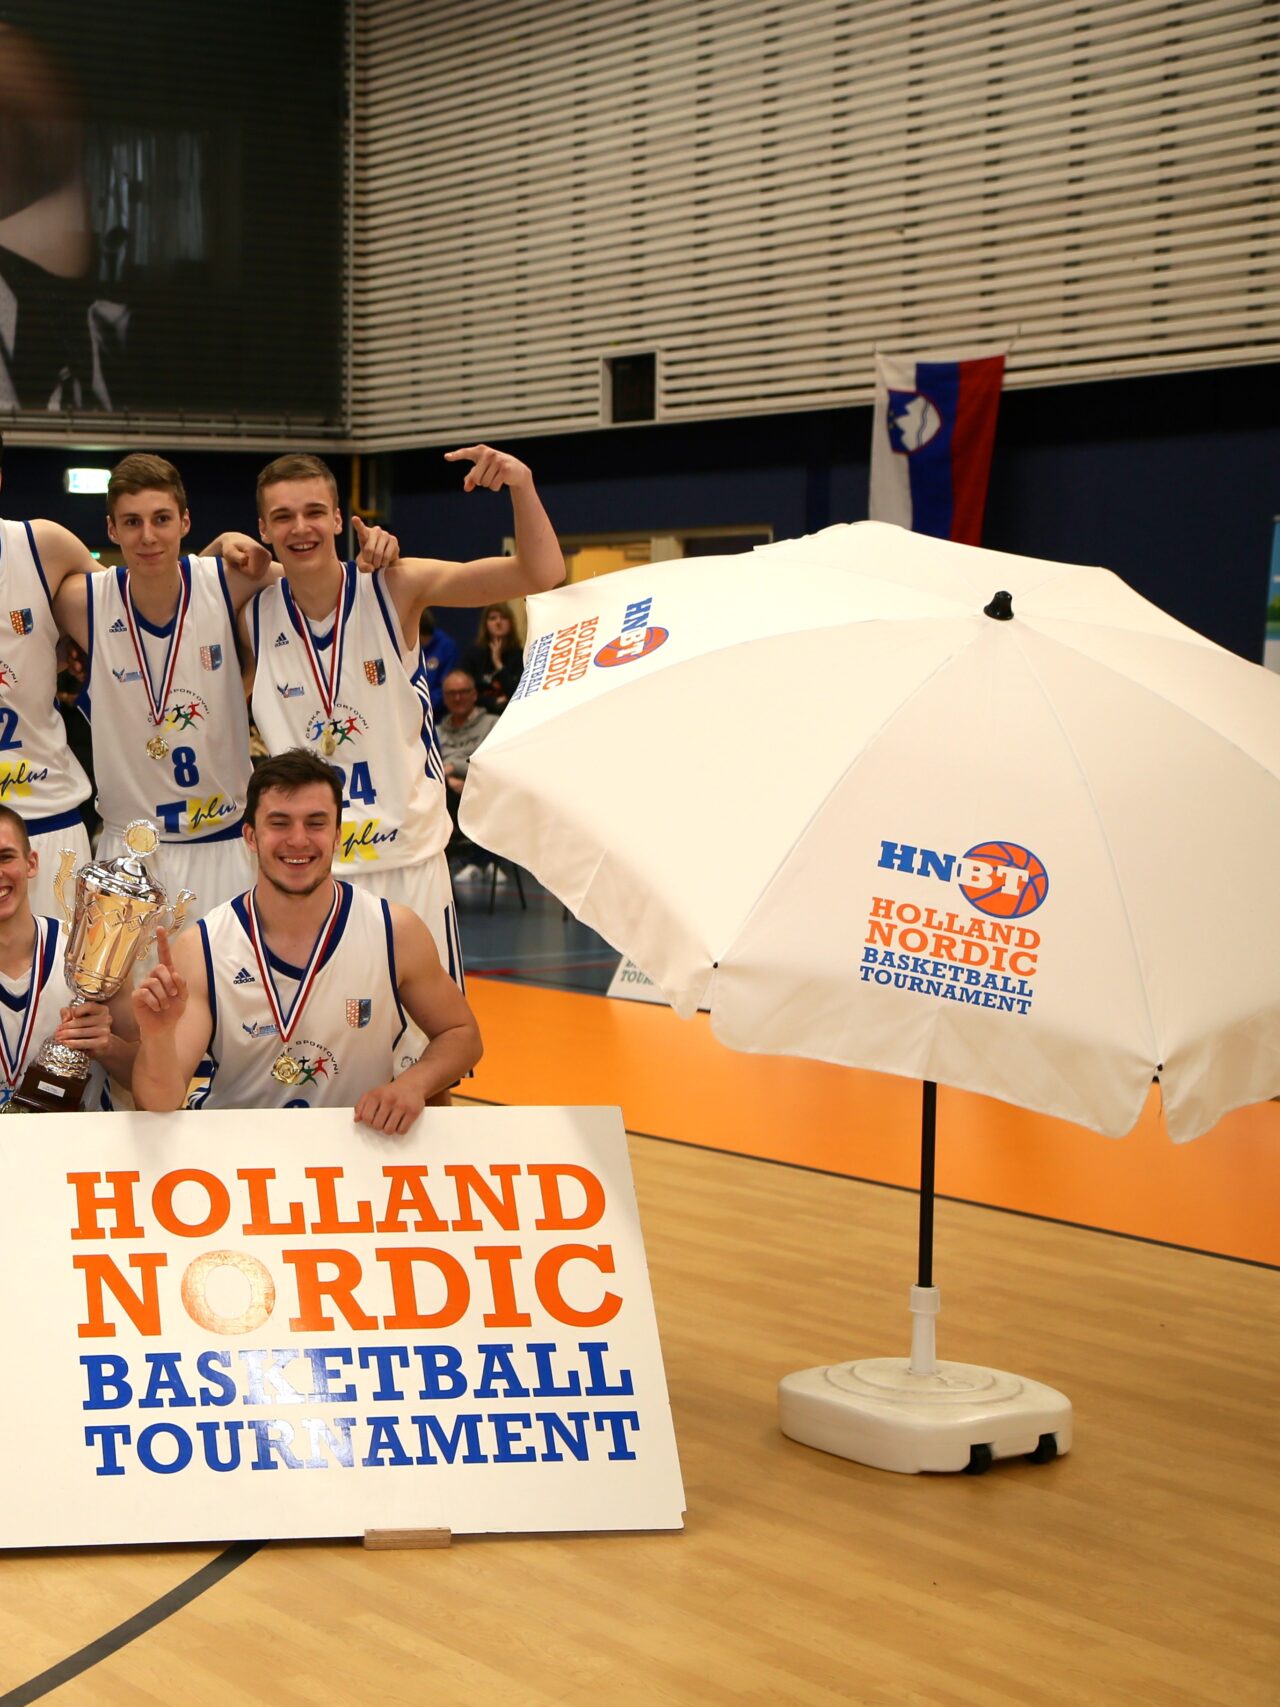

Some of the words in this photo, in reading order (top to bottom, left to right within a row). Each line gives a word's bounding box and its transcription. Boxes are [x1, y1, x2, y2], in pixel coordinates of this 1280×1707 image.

[524, 632, 555, 698] BASKETBALL
[542, 623, 579, 691] NORDIC
[567, 615, 600, 682] HOLLAND
[0, 762, 48, 797] plus
[171, 746, 200, 788] 8
[343, 822, 399, 858] plus
[877, 840, 1030, 896] HNBT
[864, 919, 1039, 977] NORDIC
[869, 896, 1041, 950] HOLLAND
[233, 976, 256, 985] adidas
[859, 965, 1032, 1016] TOURNAMENT
[861, 946, 1034, 998] BASKETBALL
[66, 1163, 607, 1240] HOLLAND
[72, 1243, 624, 1338] NORDIC
[79, 1341, 635, 1411] BASKETBALL
[85, 1410, 640, 1477] TOURNAMENT
